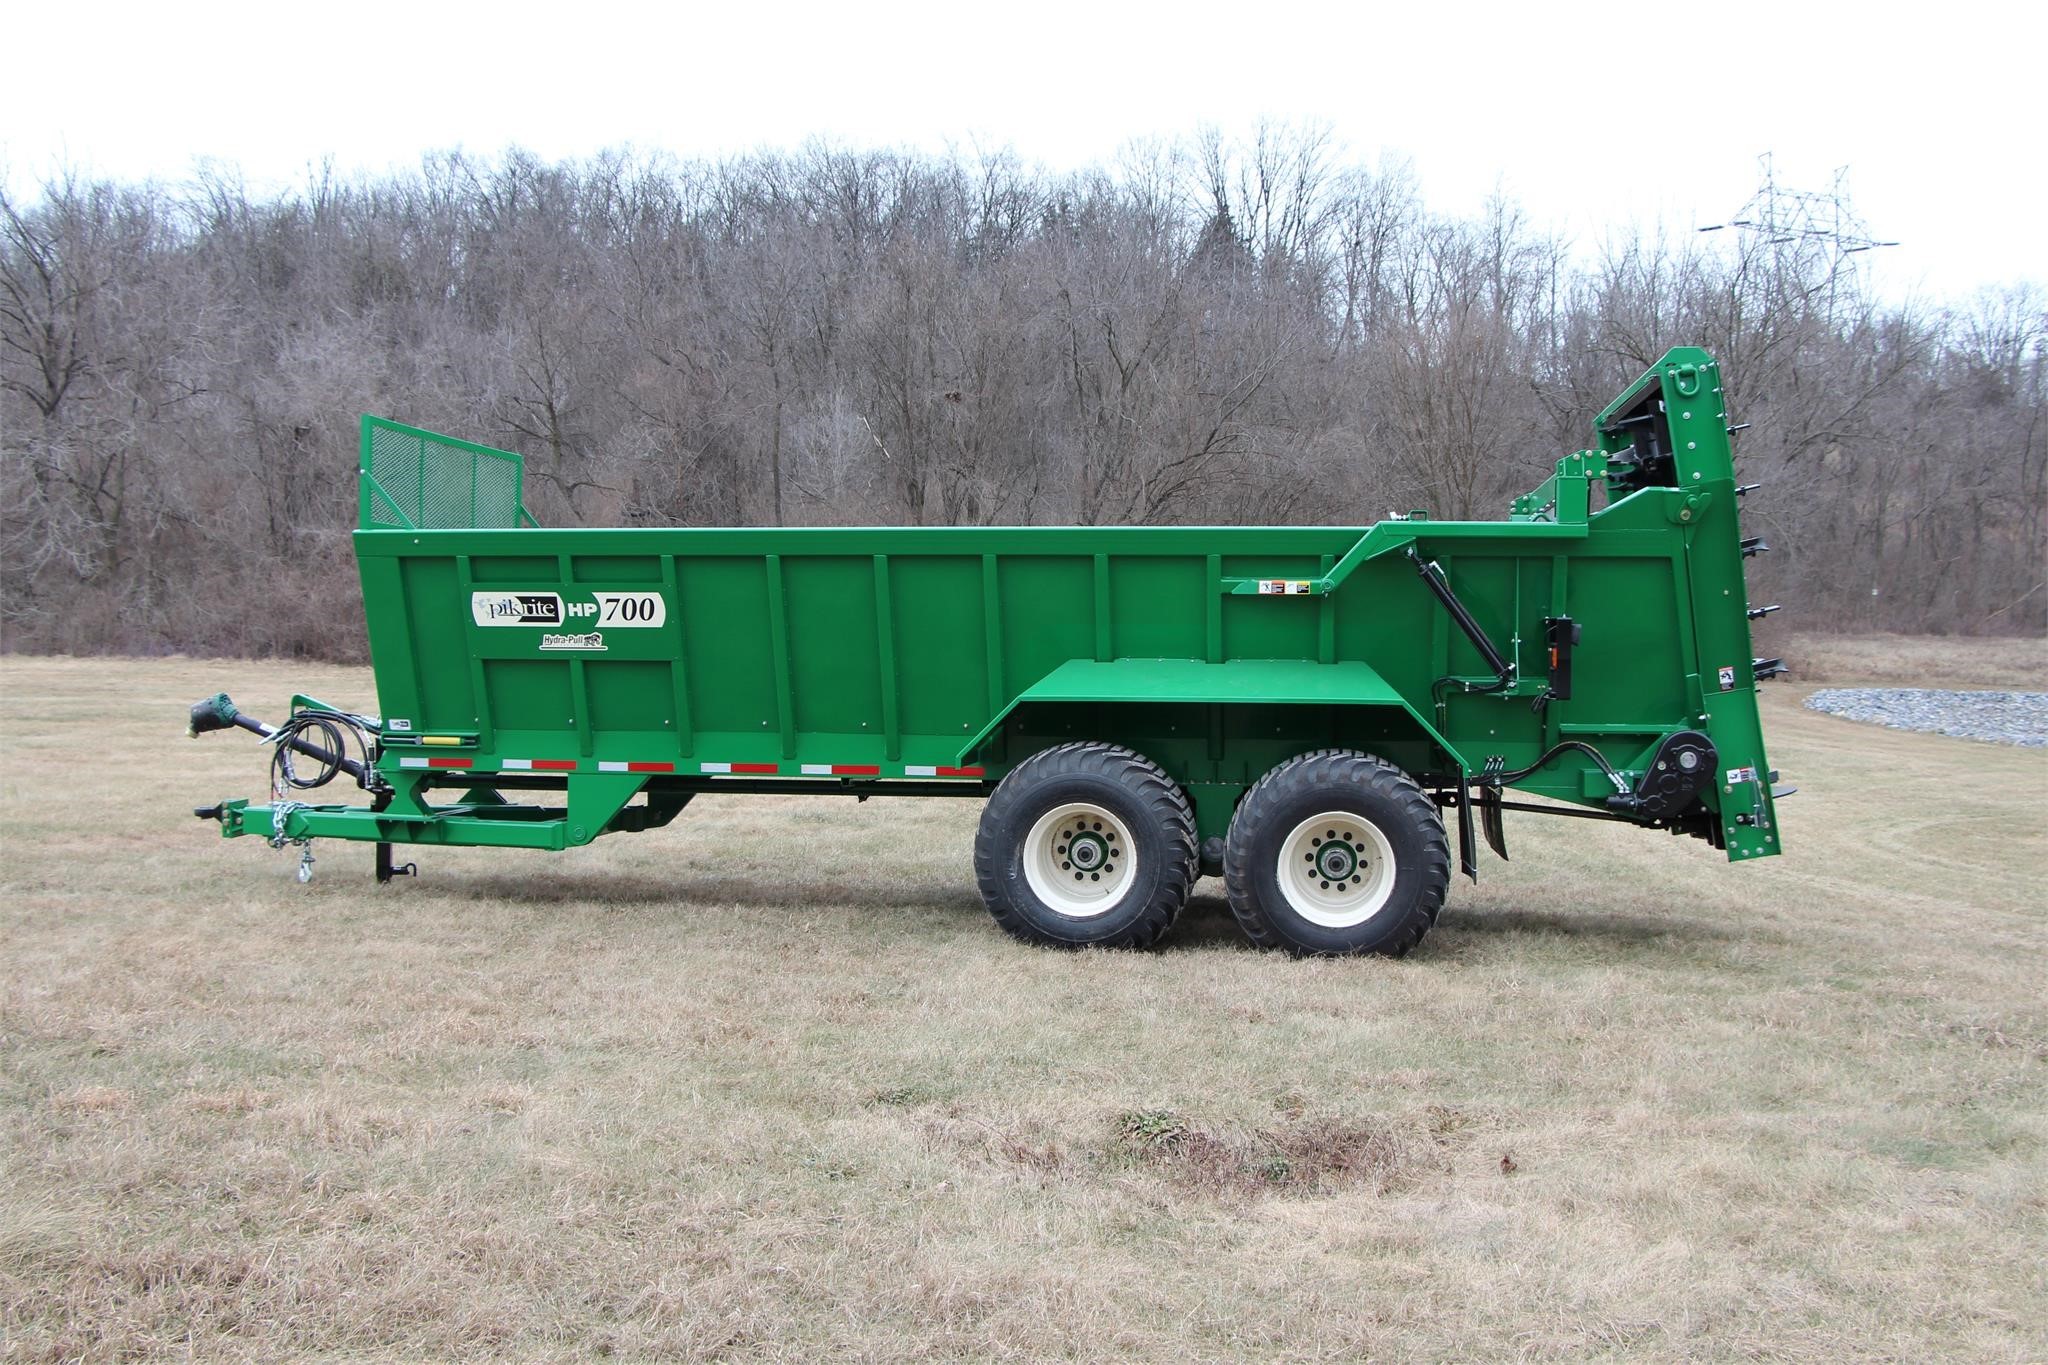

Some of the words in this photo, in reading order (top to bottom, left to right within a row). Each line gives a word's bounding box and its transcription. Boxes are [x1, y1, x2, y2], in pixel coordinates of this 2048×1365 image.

[567, 603, 598, 617] HP
[605, 597, 655, 621] 700
[544, 635, 583, 645] Hydra-Pull
